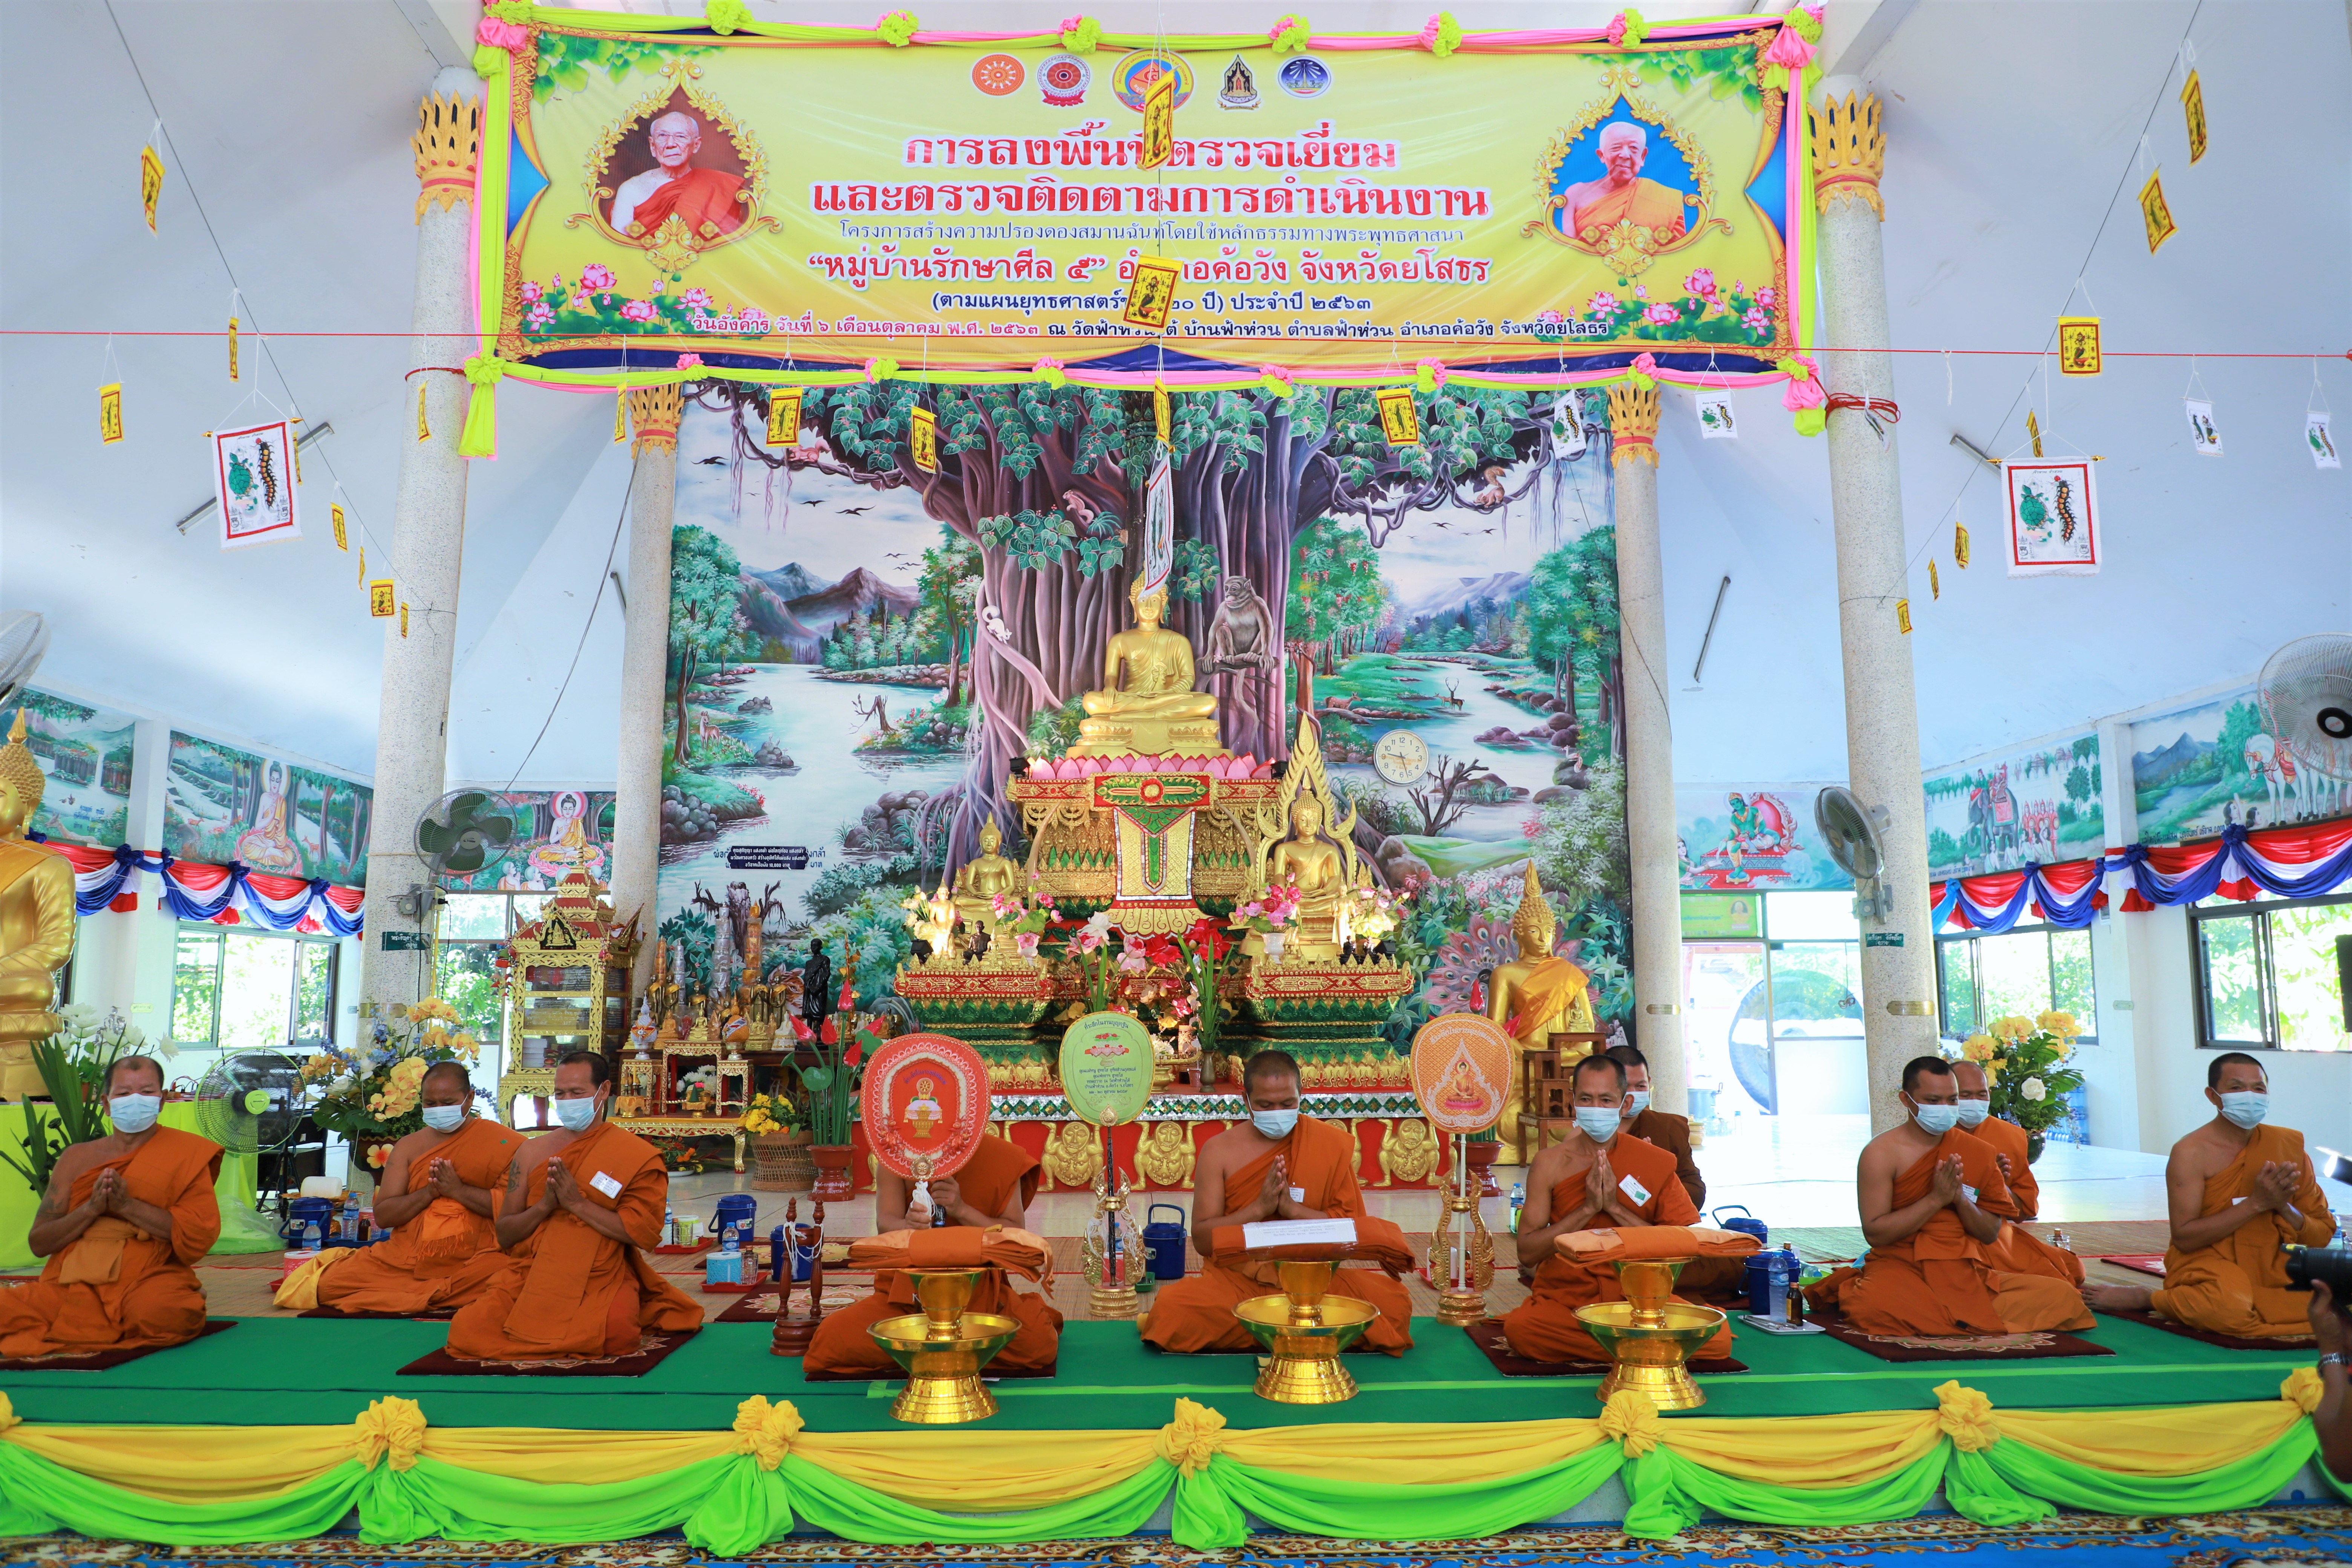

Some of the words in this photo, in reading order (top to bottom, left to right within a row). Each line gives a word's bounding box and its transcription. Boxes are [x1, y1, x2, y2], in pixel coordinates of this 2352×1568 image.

[906, 121, 1396, 167] การลงพื้นตรวจเยี่ยม
[814, 176, 1488, 215] และตรวจติดตามการดำเนินงาน
[840, 219, 1464, 242] โครงการสร้างความปรองดองสมานฉันท์โดยใช้หลักธรรมทางพระพุทธศาสนา
[1300, 249, 1490, 282] จังหวัดยโสธร
[1202, 291, 1223, 313] ปี)
[1232, 291, 1302, 310] ประจำปี
[1311, 296, 1371, 309] ๒๕๖๓
[693, 316, 769, 332] วันอังคาร
[776, 311, 812, 332] วันที่
[819, 321, 828, 332] ๖
[838, 316, 941, 338] เดือนตุลาคม
[948, 320, 983, 334] พ.ศ.
[989, 323, 1038, 334] ๒๕๖๓
[1048, 325, 1064, 335] ณ
[1184, 320, 1281, 335] บ้านฟ้าห่วน
[1288, 320, 1394, 337] ตำบลฟ้าห่วน
[1400, 319, 1494, 336] อำเภอค้อวัง
[1500, 318, 1608, 335] จังหวัดยโสธร
[1084, 1020, 1129, 1029] ที่ระลึกในงานบุญกฐิน
